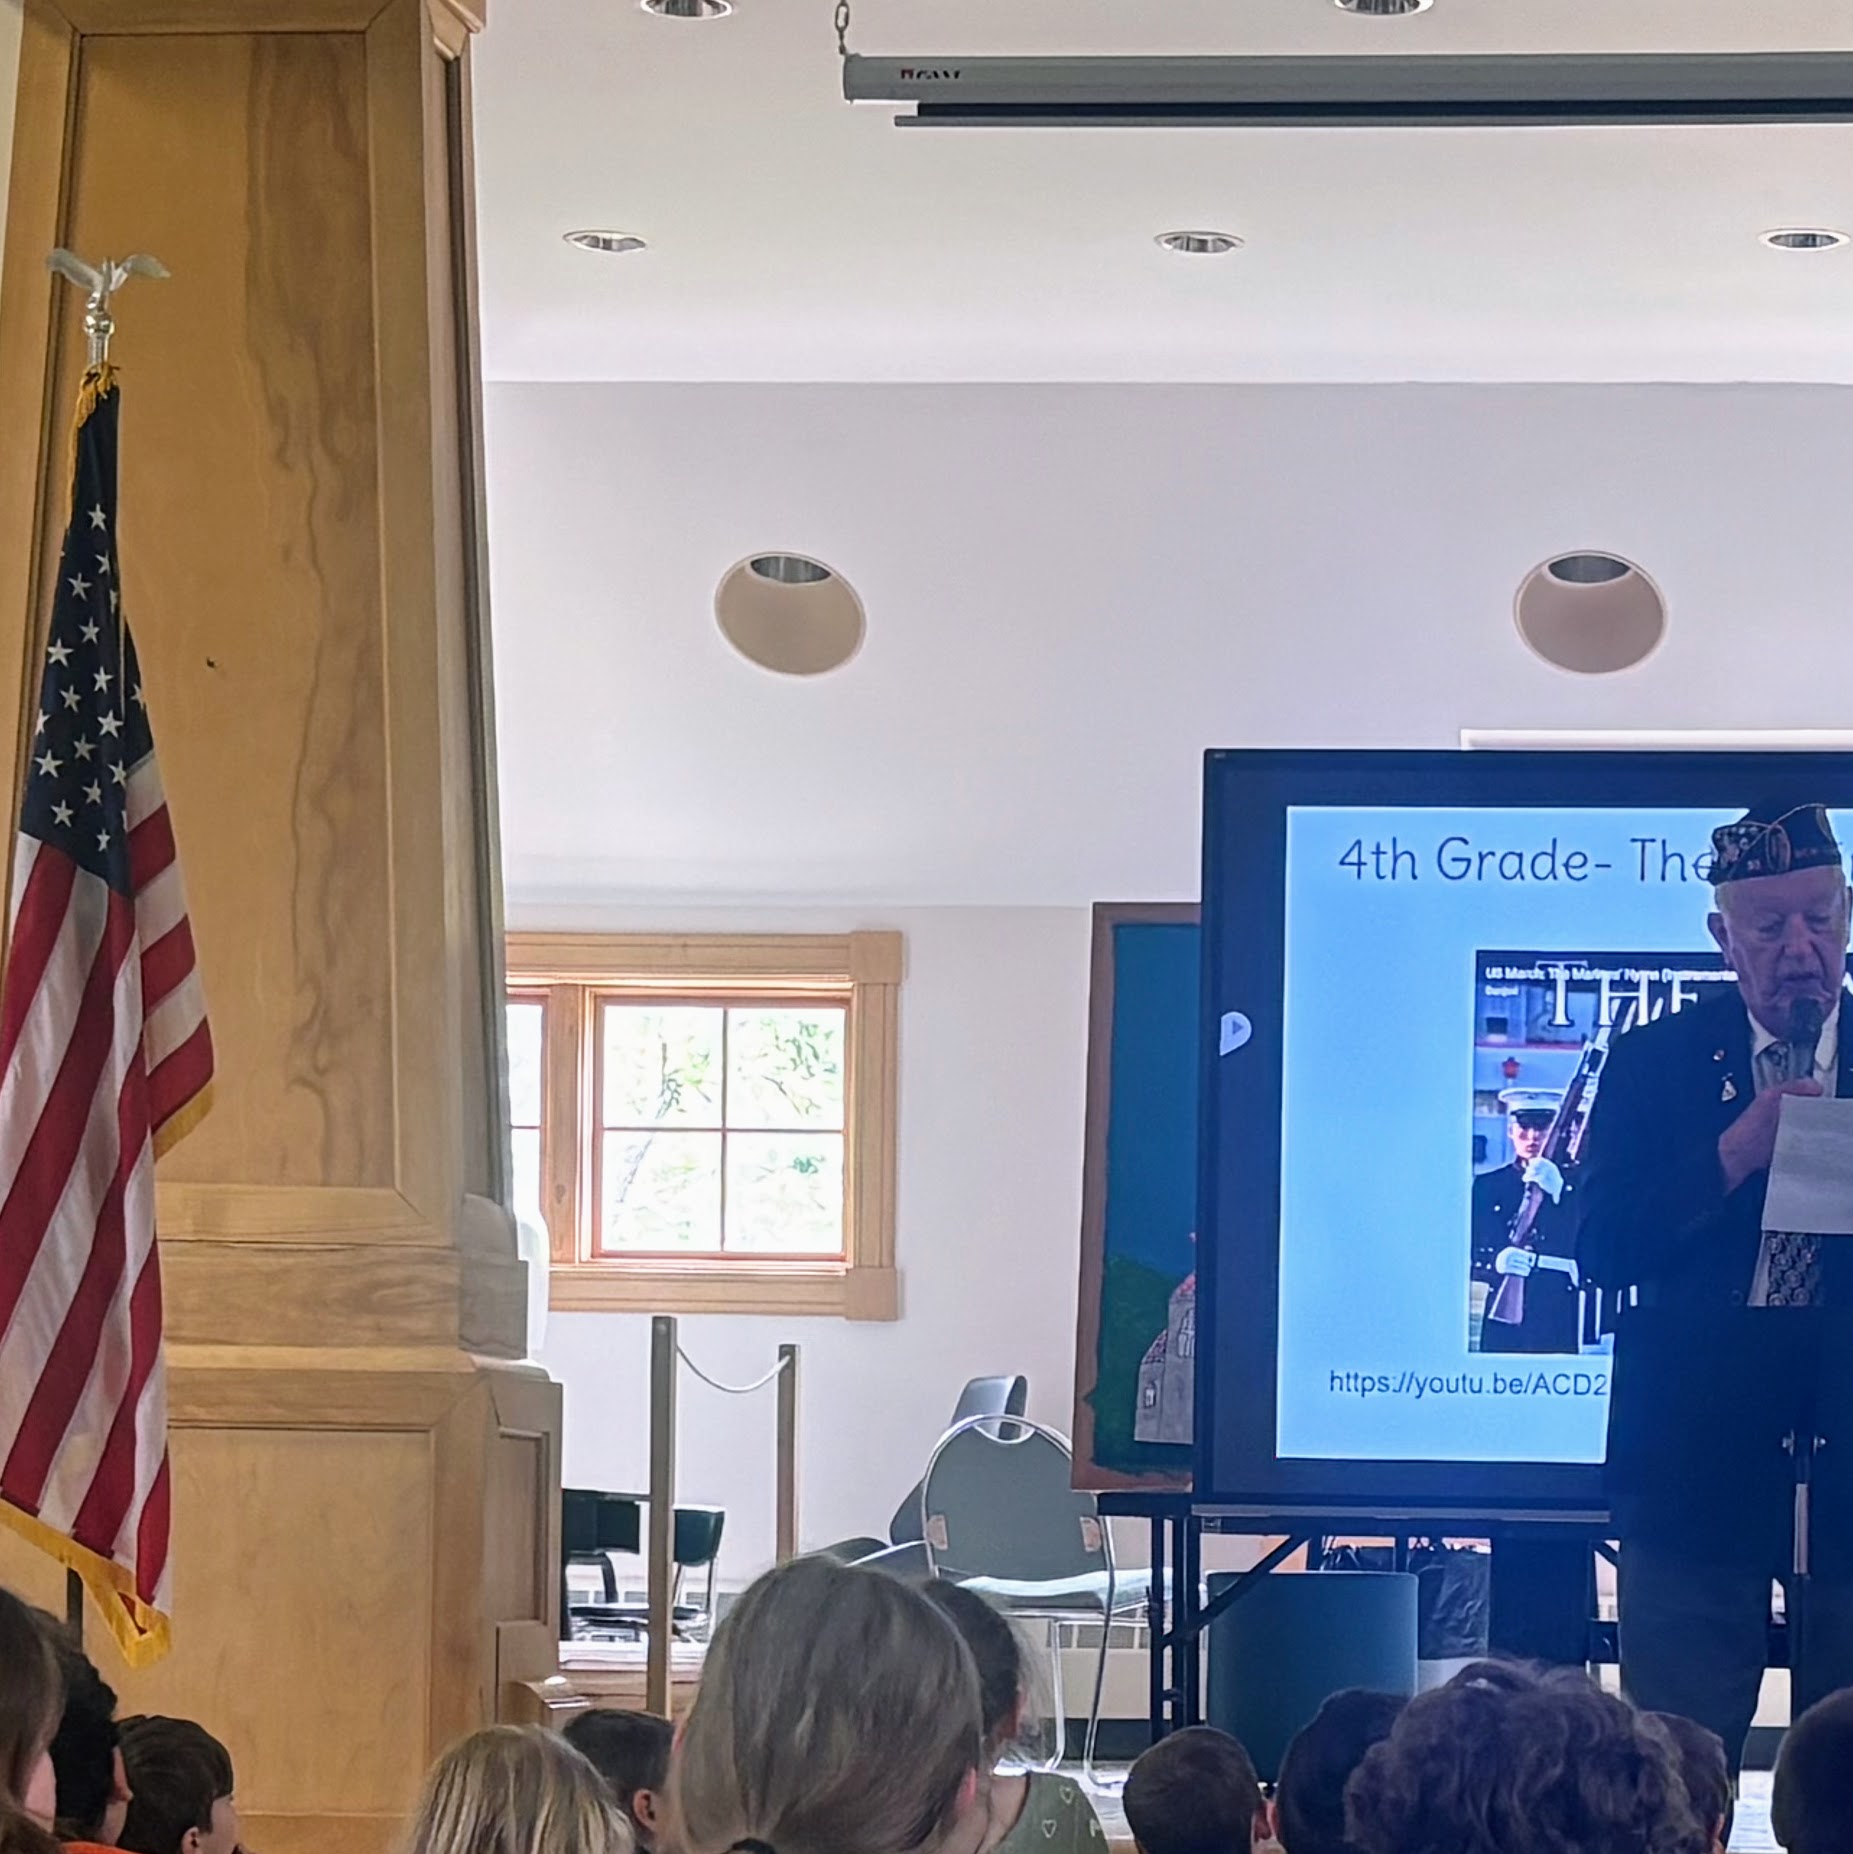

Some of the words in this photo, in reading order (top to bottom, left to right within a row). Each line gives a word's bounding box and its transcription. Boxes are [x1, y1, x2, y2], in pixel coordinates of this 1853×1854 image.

[1338, 837, 1418, 881] 4th
[1436, 836, 1612, 882] Grade-
[1629, 838, 1716, 883] The
